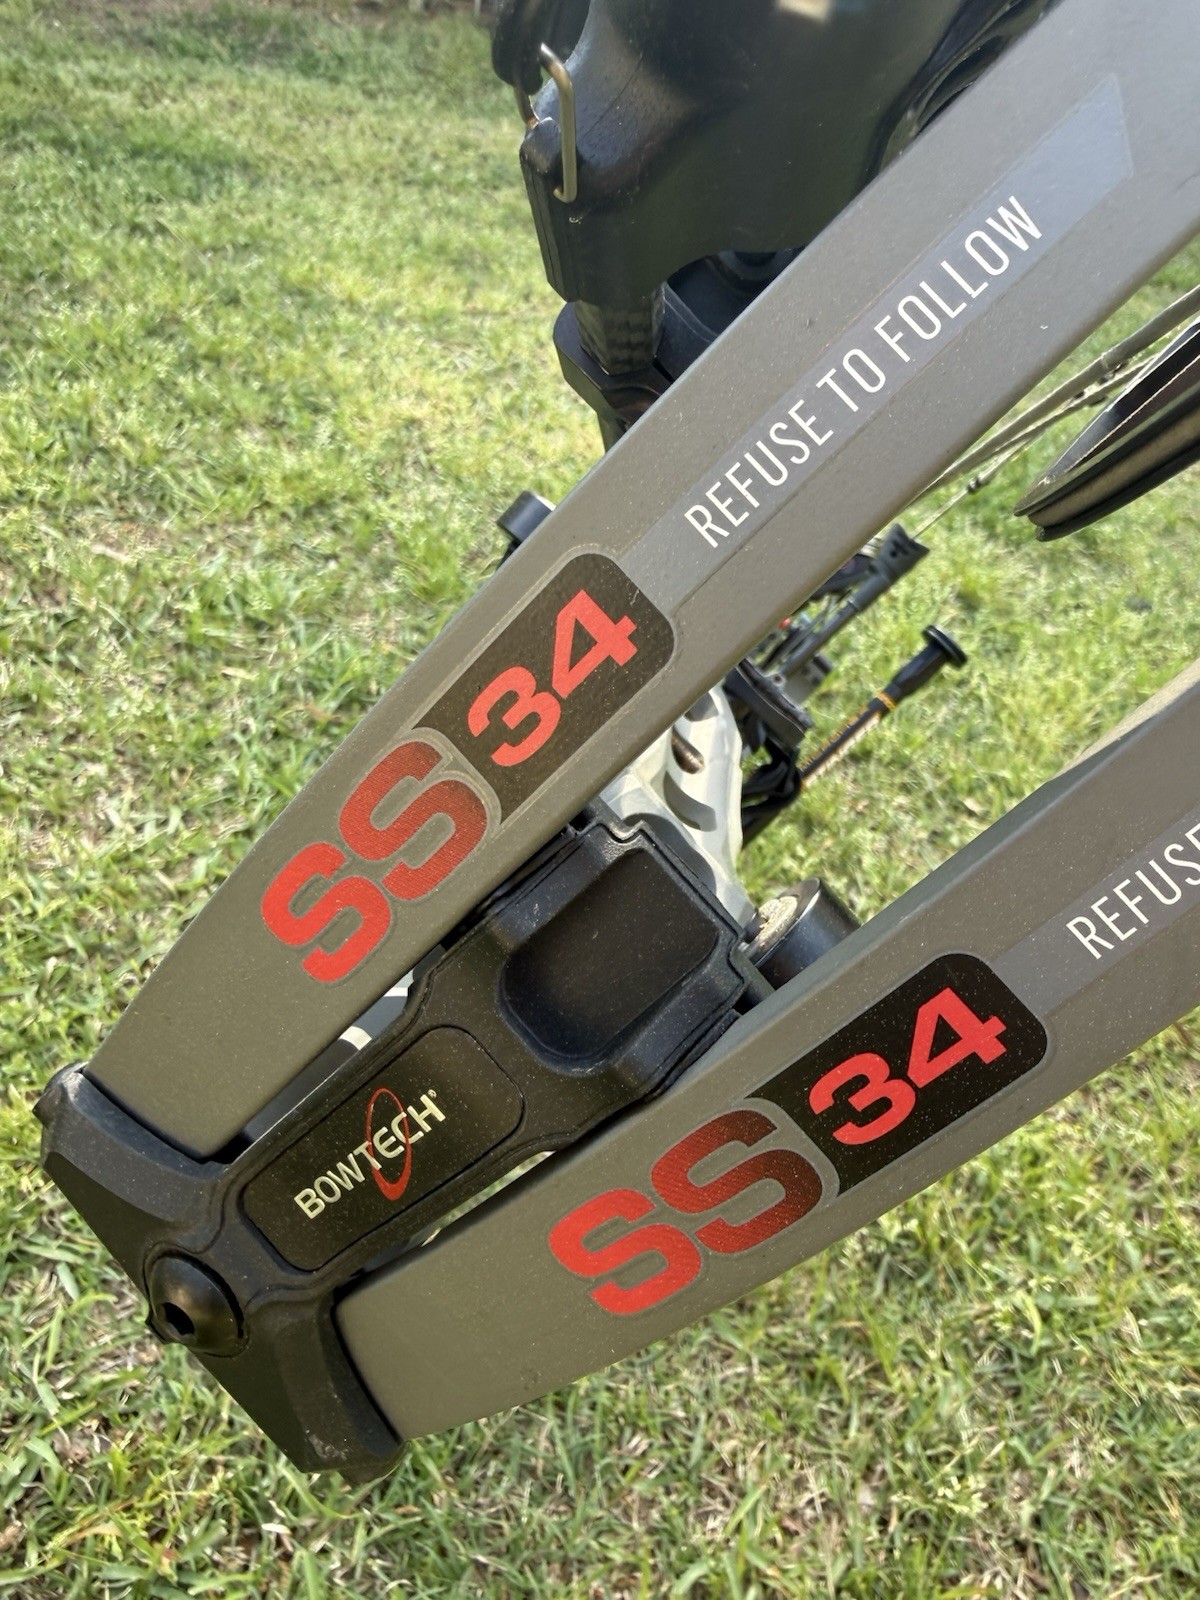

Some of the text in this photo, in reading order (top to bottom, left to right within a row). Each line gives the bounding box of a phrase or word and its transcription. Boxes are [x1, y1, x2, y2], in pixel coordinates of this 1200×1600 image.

[684, 196, 1042, 548] REFUSE TO FOLLOW
